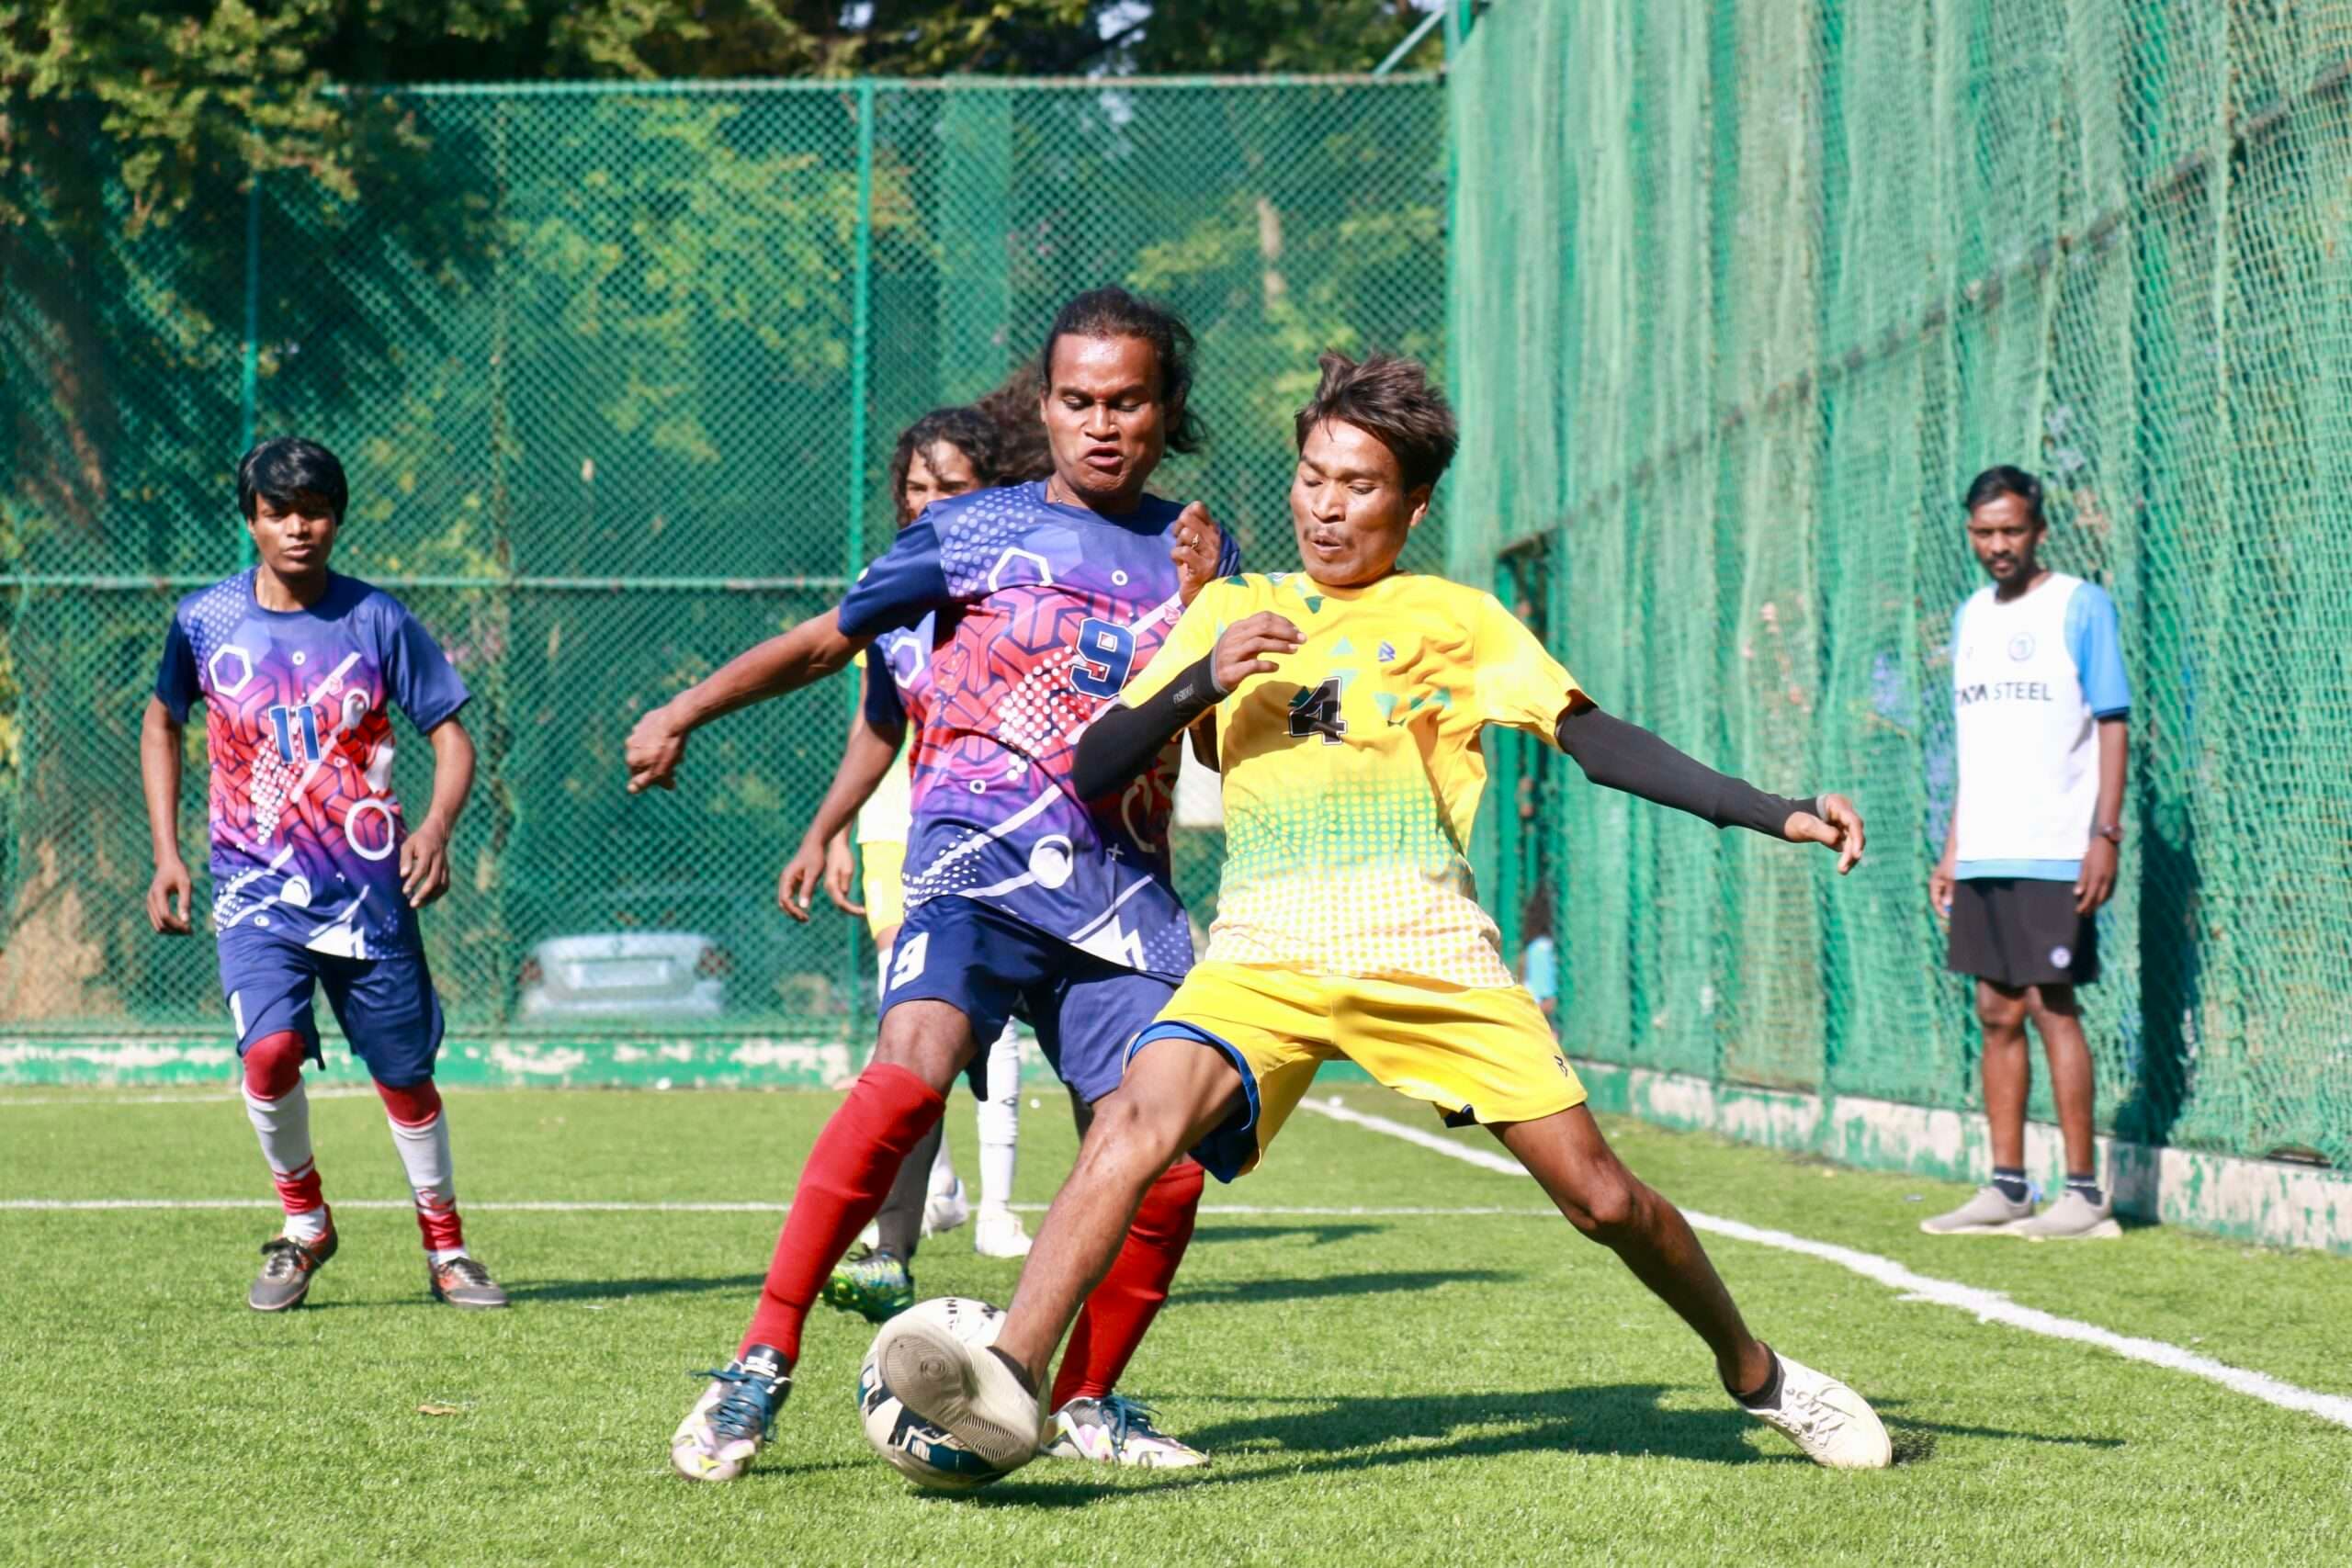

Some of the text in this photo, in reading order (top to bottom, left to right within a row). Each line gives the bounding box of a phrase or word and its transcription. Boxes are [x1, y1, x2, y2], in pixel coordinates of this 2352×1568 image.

[1069, 616, 1137, 700] 9
[1288, 675, 1348, 746] 4
[1994, 681, 2054, 702] STEEL
[268, 704, 322, 764] 11
[889, 931, 930, 990] 9
